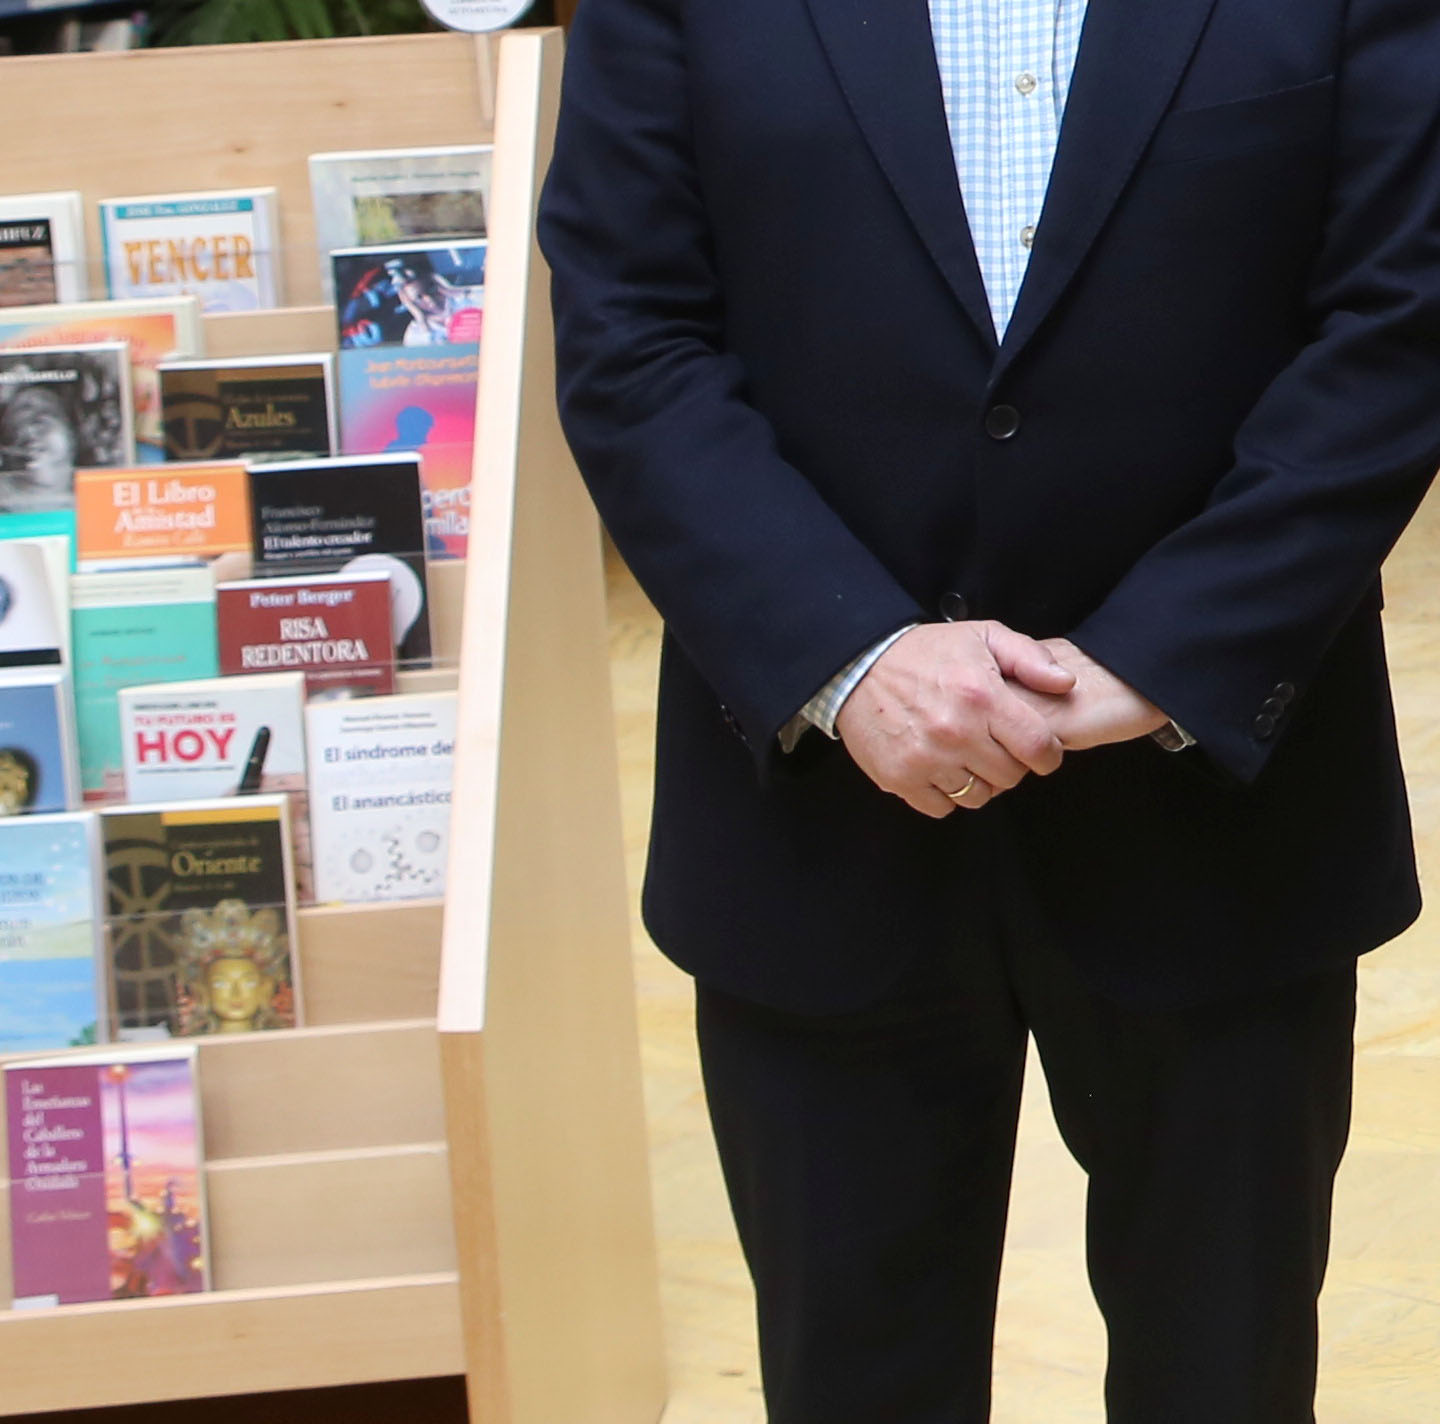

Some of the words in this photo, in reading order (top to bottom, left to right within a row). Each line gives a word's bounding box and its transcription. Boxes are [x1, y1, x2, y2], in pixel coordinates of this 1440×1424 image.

[123, 233, 254, 285] VENCER
[226, 403, 297, 430] Azules
[112, 480, 141, 507] El
[147, 479, 217, 504] Libro
[112, 504, 217, 533] Amistad
[249, 591, 295, 609] Peter
[297, 588, 354, 608] Berger
[280, 616, 328, 641] RISA
[241, 638, 370, 669] REDENTORA
[135, 728, 236, 764] HOY
[324, 747, 340, 763] El
[345, 743, 428, 761] síndrome
[332, 795, 347, 812] El
[170, 850, 263, 877] Oriente
